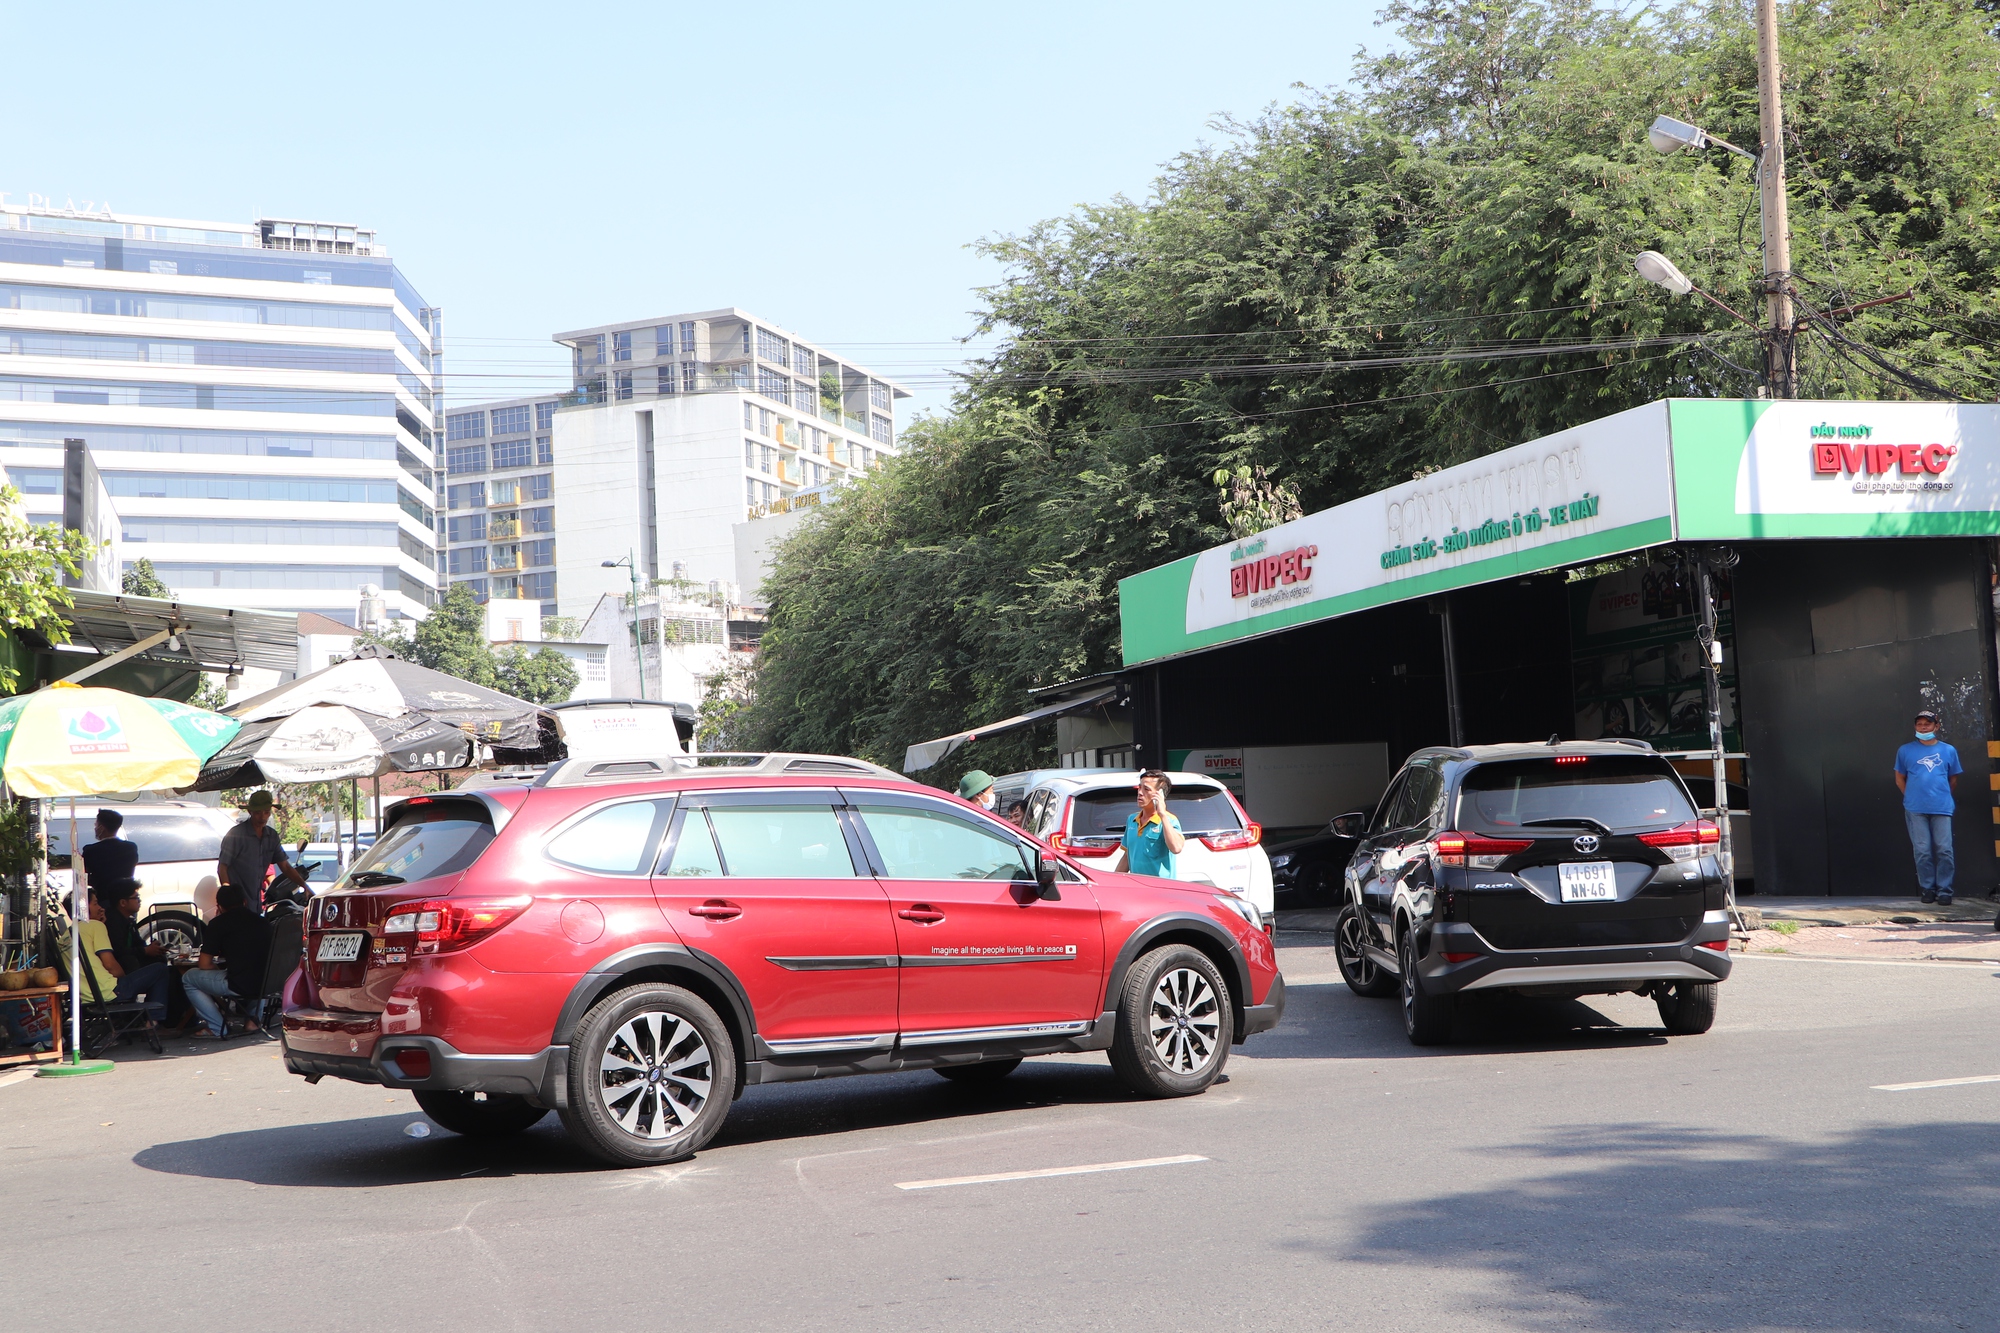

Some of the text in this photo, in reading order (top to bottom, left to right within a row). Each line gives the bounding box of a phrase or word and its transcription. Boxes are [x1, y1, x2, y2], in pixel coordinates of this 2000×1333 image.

[1810, 422, 1873, 438] DẦU NHỚT
[1841, 444, 1949, 474] VIPEC
[1923, 481, 1943, 491] động
[769, 498, 790, 514] MINH
[795, 492, 821, 509] HOTEL
[1511, 512, 1523, 537] Ô
[1569, 492, 1599, 522] MÁY
[1245, 546, 1312, 593] VIPEC
[1607, 591, 1639, 610] VIPEC
[1565, 864, 1607, 881] 41-691
[1571, 882, 1606, 898] NN-46
[931, 944, 1064, 956] Imagine all the people living life in peace
